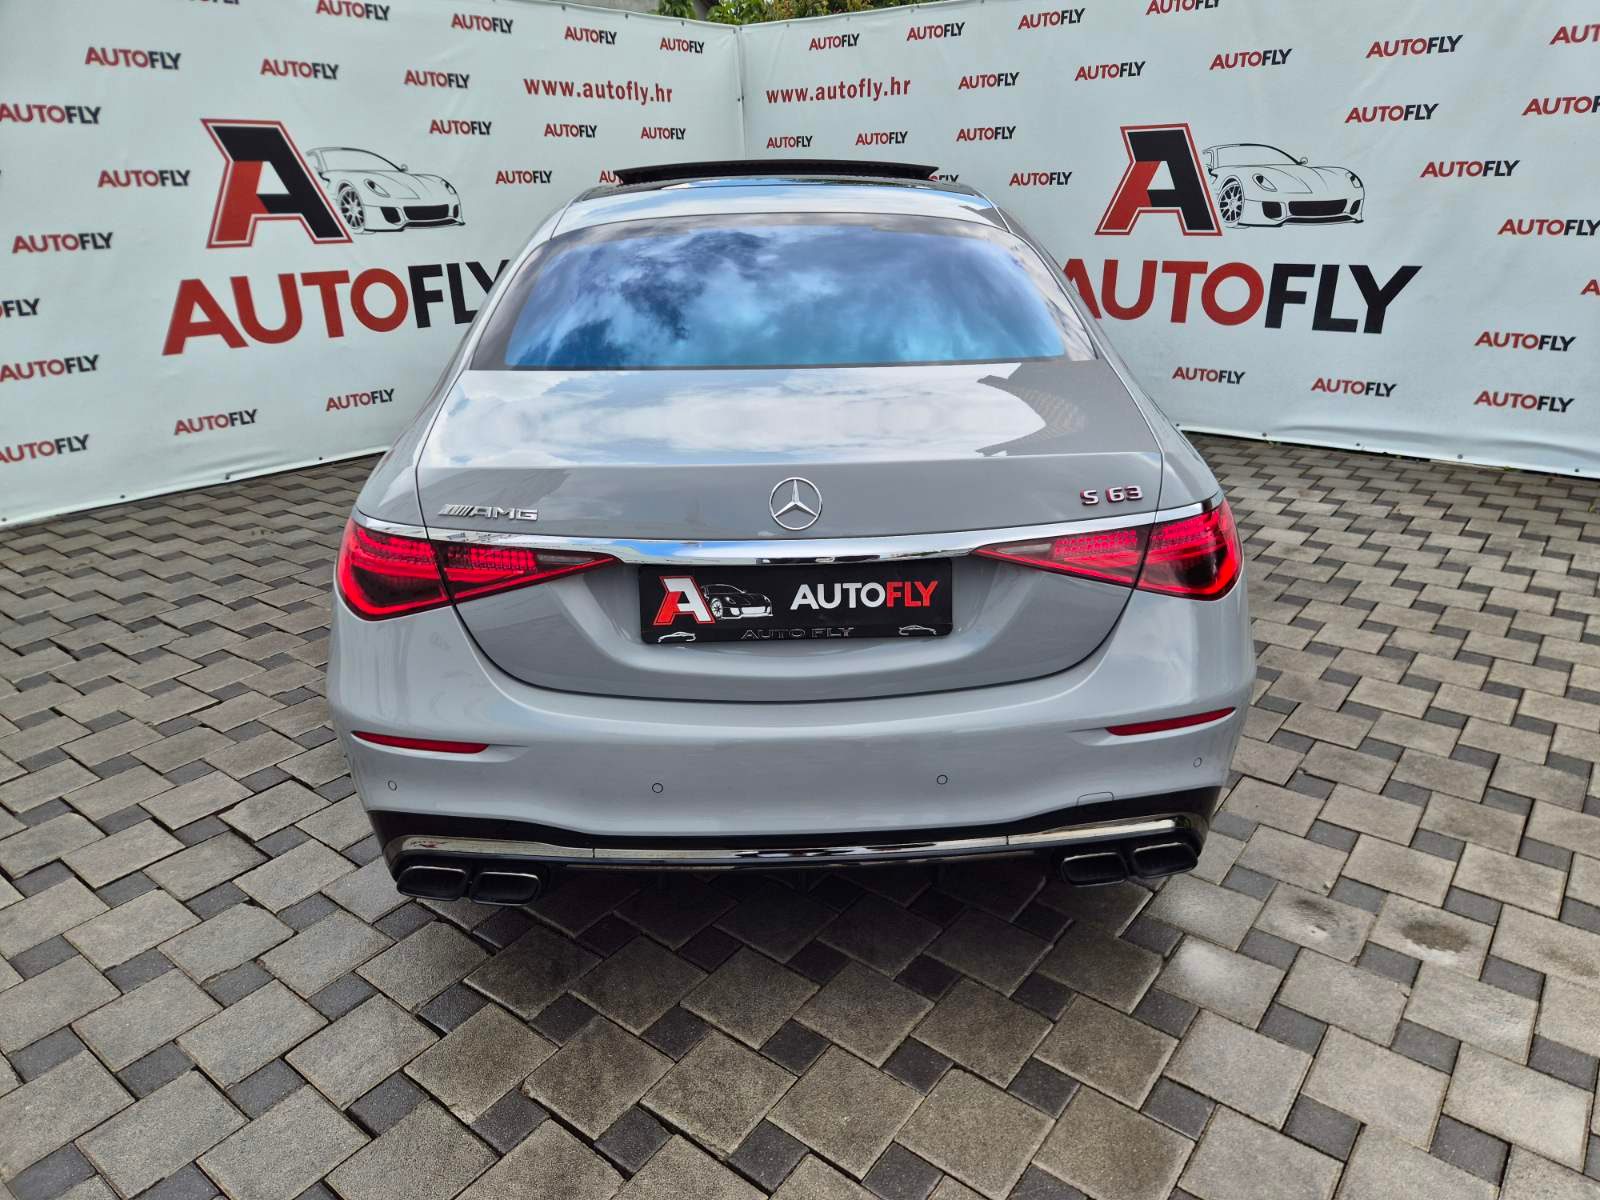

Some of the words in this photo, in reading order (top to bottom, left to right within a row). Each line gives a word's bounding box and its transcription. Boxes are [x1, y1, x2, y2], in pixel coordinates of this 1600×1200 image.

[316, 0, 390, 21] AUTOFLY
[1018, 8, 1085, 30] AUTOFLY
[451, 13, 513, 34] AUTOFLY
[907, 22, 965, 41] AUTOFLY
[564, 26, 617, 45] AUTOFLY
[809, 33, 860, 51] AUTOFLY
[660, 37, 704, 54] AUTOFLY
[1366, 35, 1463, 58] AUTOFLY
[85, 47, 181, 70] AUTOFLY
[1209, 48, 1292, 70] AUTOFLY
[260, 59, 339, 80] AUTOFLY
[1075, 61, 1146, 81] AUTOFLY
[404, 70, 470, 89] AUTOFLY
[958, 72, 1020, 90] AUTOFLY
[523, 79, 672, 105] www.autofly.hr
[766, 77, 910, 103] www.autofly.hr
[0, 103, 101, 124] AUTOFLY
[1345, 103, 1439, 123] AUTOFLY
[429, 120, 492, 135] AUTOFLY
[544, 123, 597, 138] AUTOFLY
[641, 127, 686, 140] AUTOFLY
[956, 126, 1016, 142] AUTOFLY
[766, 136, 813, 149] AUTOFLY
[855, 131, 908, 145] AUTOFLY
[98, 170, 190, 187] AUTOFLY
[496, 170, 552, 184] AUTOFLY
[1420, 160, 1520, 178] AUTOFLY
[1009, 172, 1072, 186] AUTOFLY
[1498, 219, 1600, 236] AUTOFLY
[12, 232, 113, 254] AUTOFLY
[1474, 332, 1576, 352] AUTOFLY
[0, 354, 99, 382] AUTOFLY
[1172, 367, 1245, 384] AUTOFLY
[1311, 378, 1397, 397] AUTOFLY
[326, 388, 394, 411] AUTOFLY
[1474, 391, 1575, 413] AUTOFLY
[174, 409, 257, 435] AUTOFLY
[1080, 489, 1100, 506] S
[1105, 485, 1143, 504] 63
[467, 505, 538, 521] AMG
[789, 580, 939, 611] AUTOFLY
